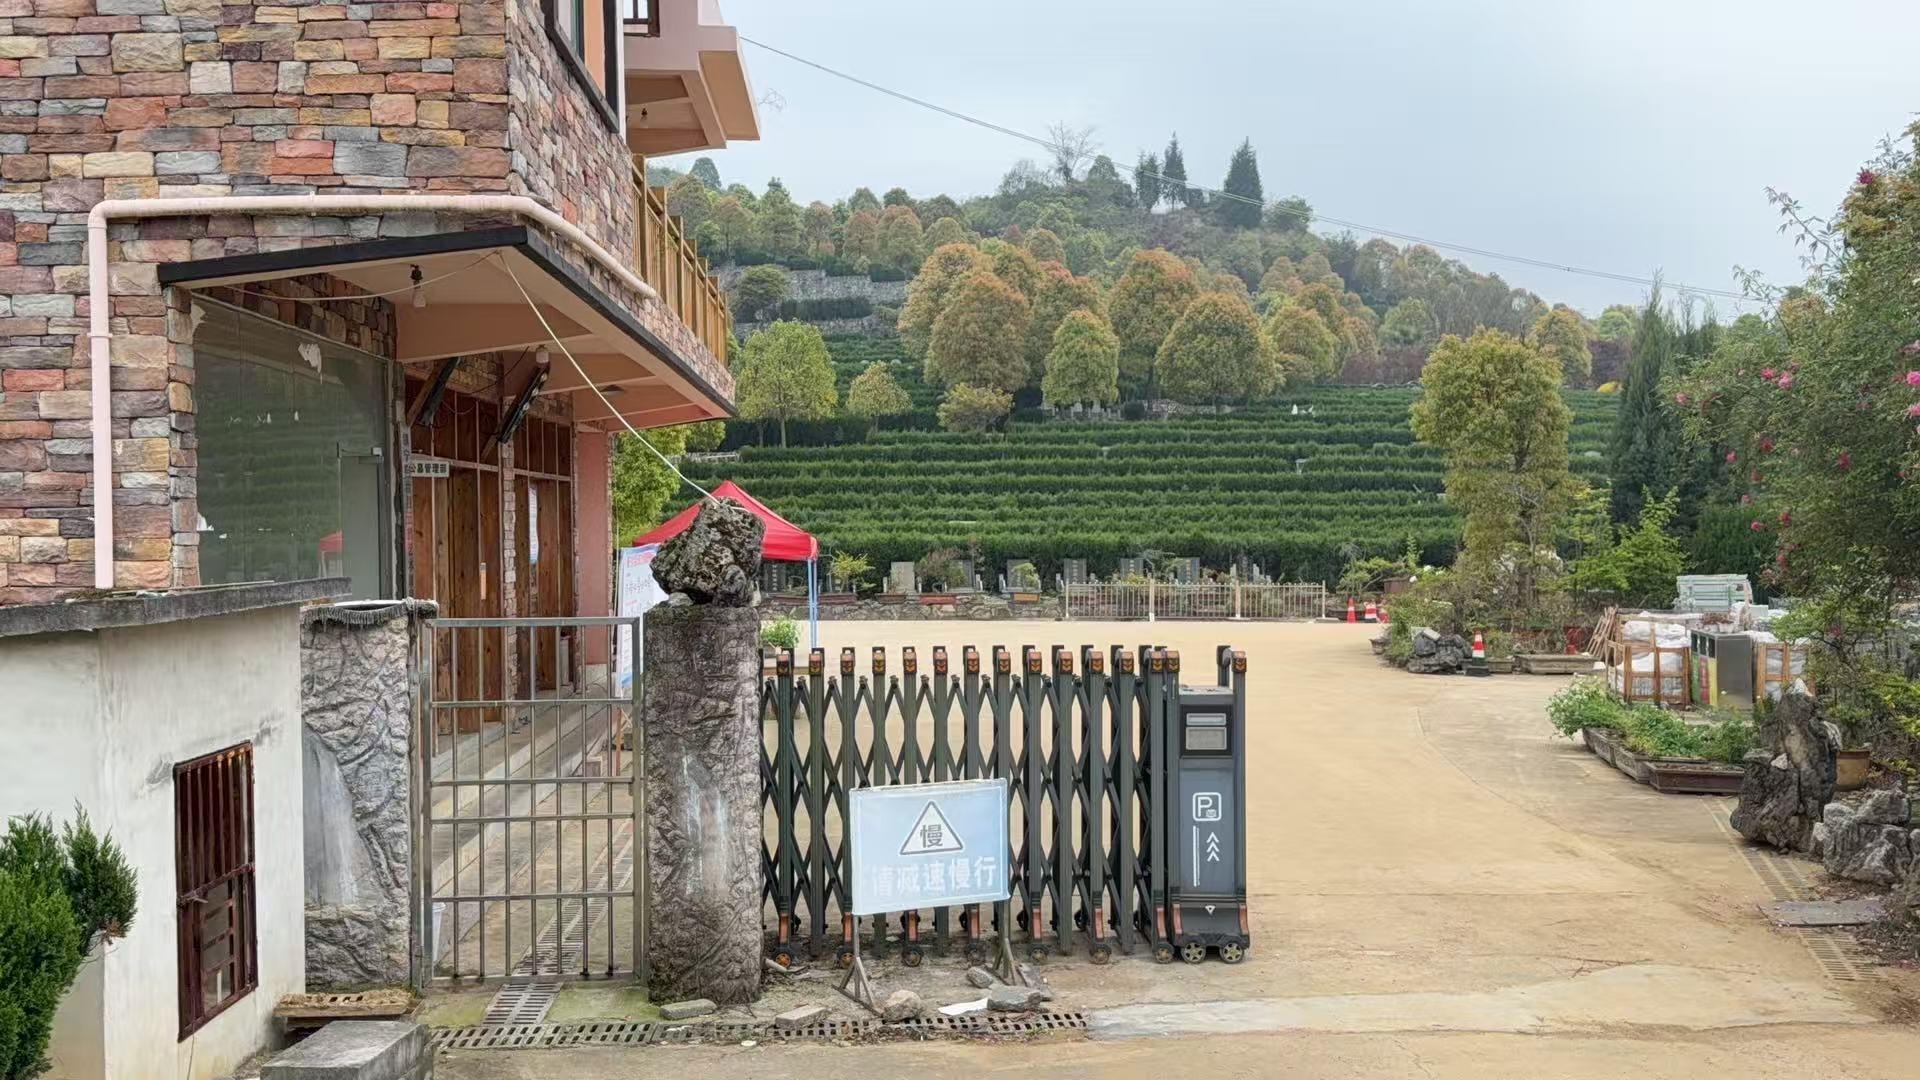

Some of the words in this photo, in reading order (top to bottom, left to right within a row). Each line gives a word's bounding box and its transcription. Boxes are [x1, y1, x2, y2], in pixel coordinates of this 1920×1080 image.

[1197, 796, 1213, 817] P
[920, 824, 943, 848] 慢
[872, 856, 996, 897] 请减速慢行
